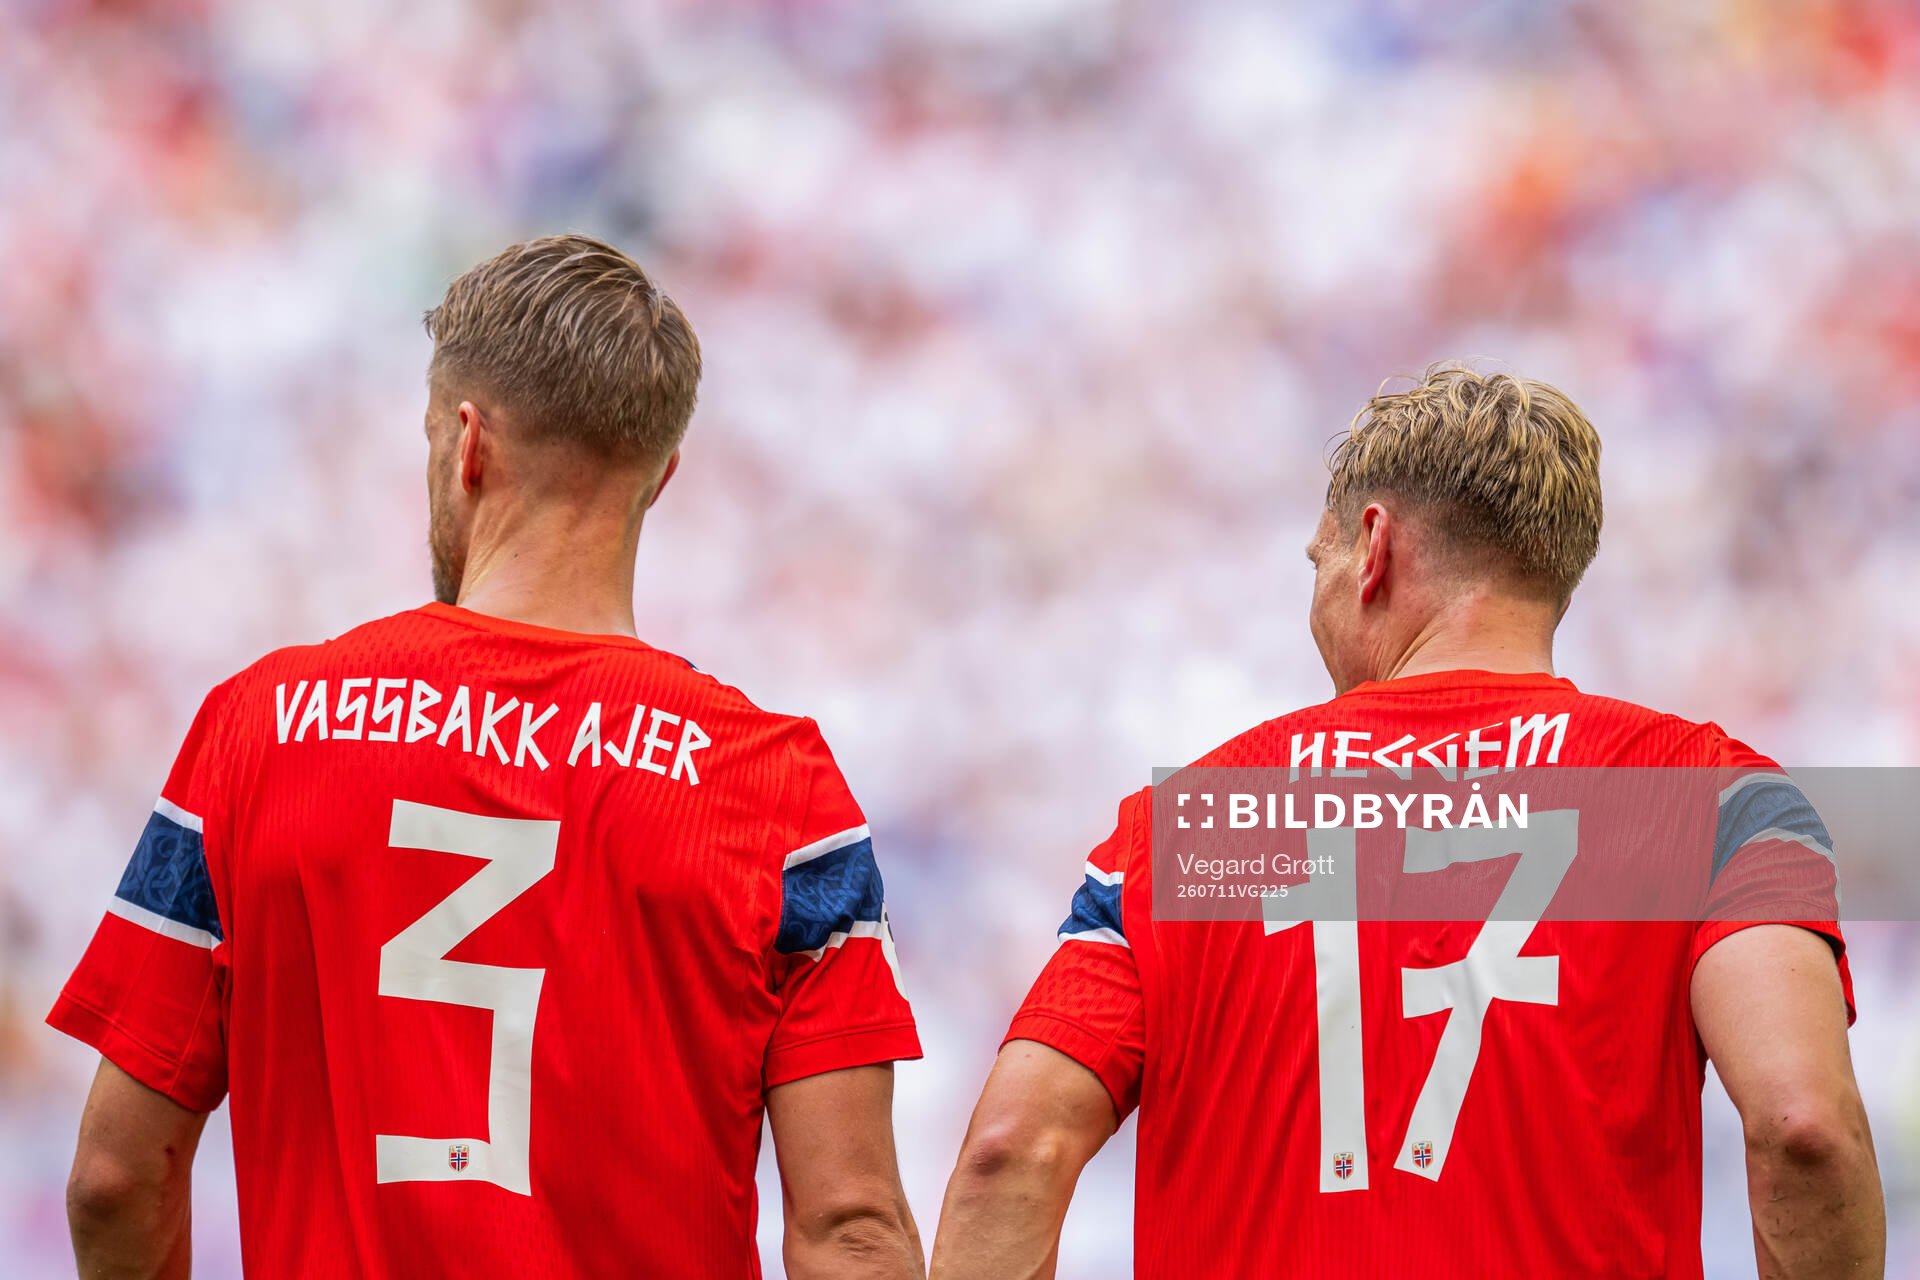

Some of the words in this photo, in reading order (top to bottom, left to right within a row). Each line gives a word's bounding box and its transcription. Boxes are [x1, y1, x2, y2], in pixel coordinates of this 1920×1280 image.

[276, 677, 559, 771] VASSBAKK
[567, 701, 712, 786] AJER
[1289, 712, 1571, 783] HEGGEM
[376, 799, 561, 1197] 3
[1262, 808, 1580, 1193] 17
